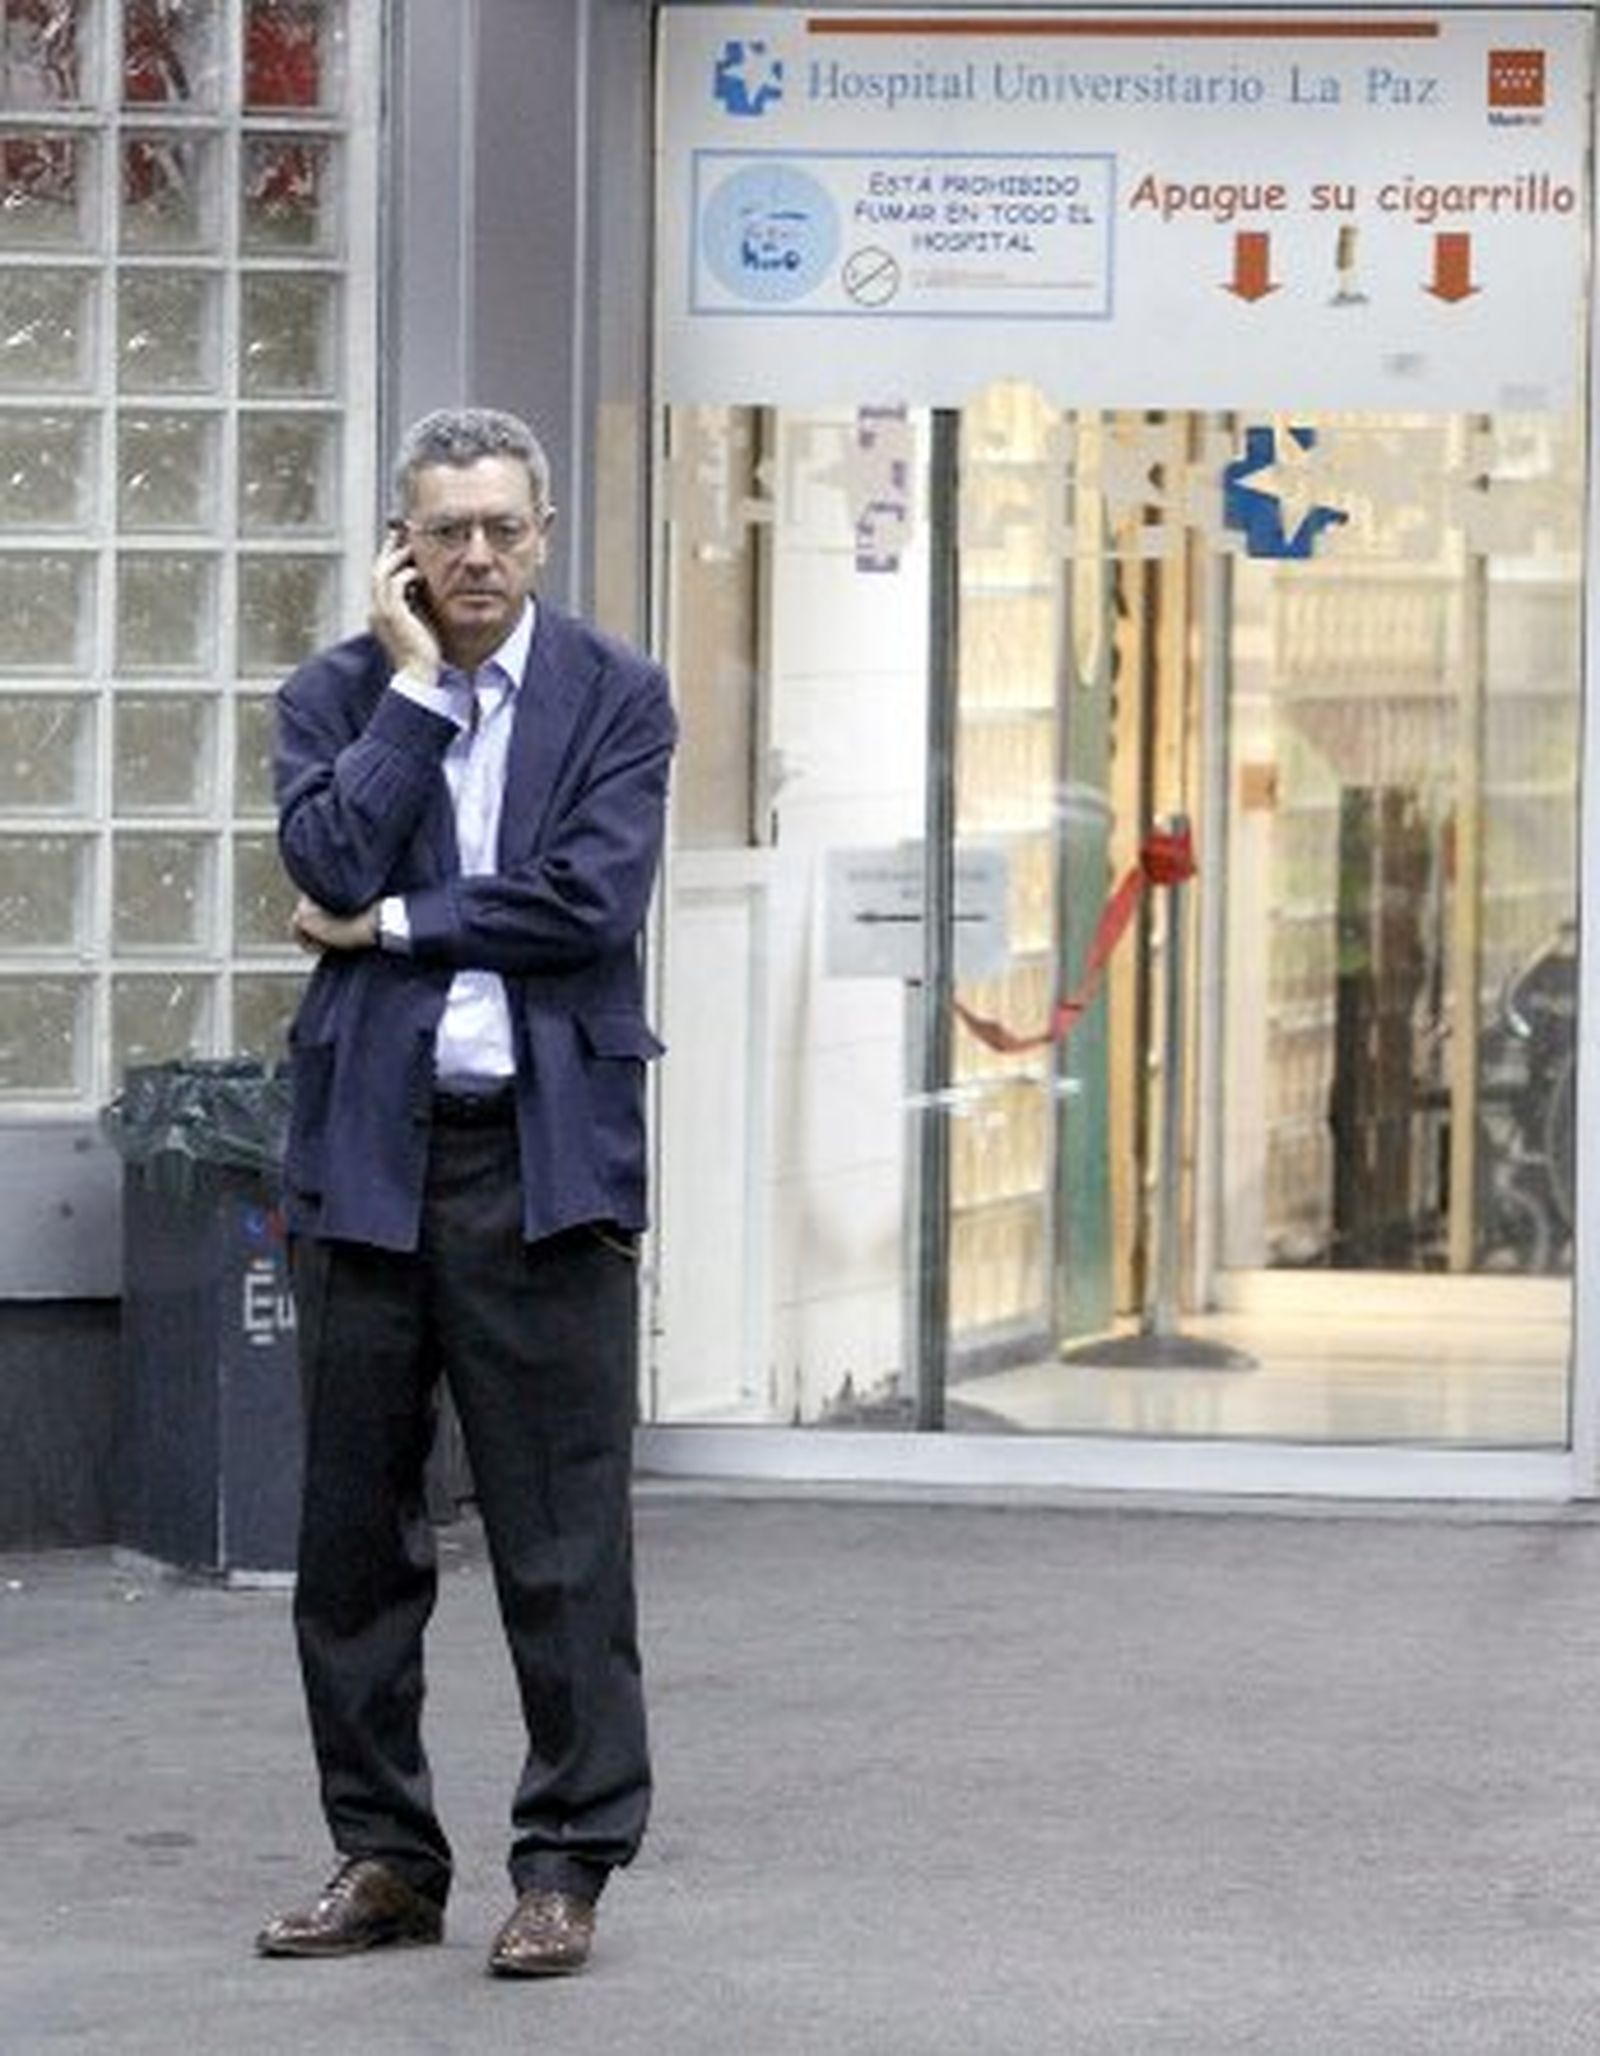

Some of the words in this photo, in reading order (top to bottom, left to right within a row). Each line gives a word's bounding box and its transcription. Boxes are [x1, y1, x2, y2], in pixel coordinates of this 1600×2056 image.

[808, 62, 974, 107] Hospital
[993, 63, 1264, 102] Universitario
[1291, 66, 1341, 103] La
[1367, 67, 1440, 105] Paz
[942, 176, 1080, 197] PROHIBIDO
[1130, 175, 1287, 223] Apague
[1311, 184, 1356, 211] su
[1377, 174, 1576, 223] cigarrillo
[854, 201, 936, 222] FUMAR
[946, 203, 978, 224] EN
[989, 204, 1058, 224] TODO
[1067, 204, 1096, 224] EL
[911, 231, 1035, 252] HOSPITAL
